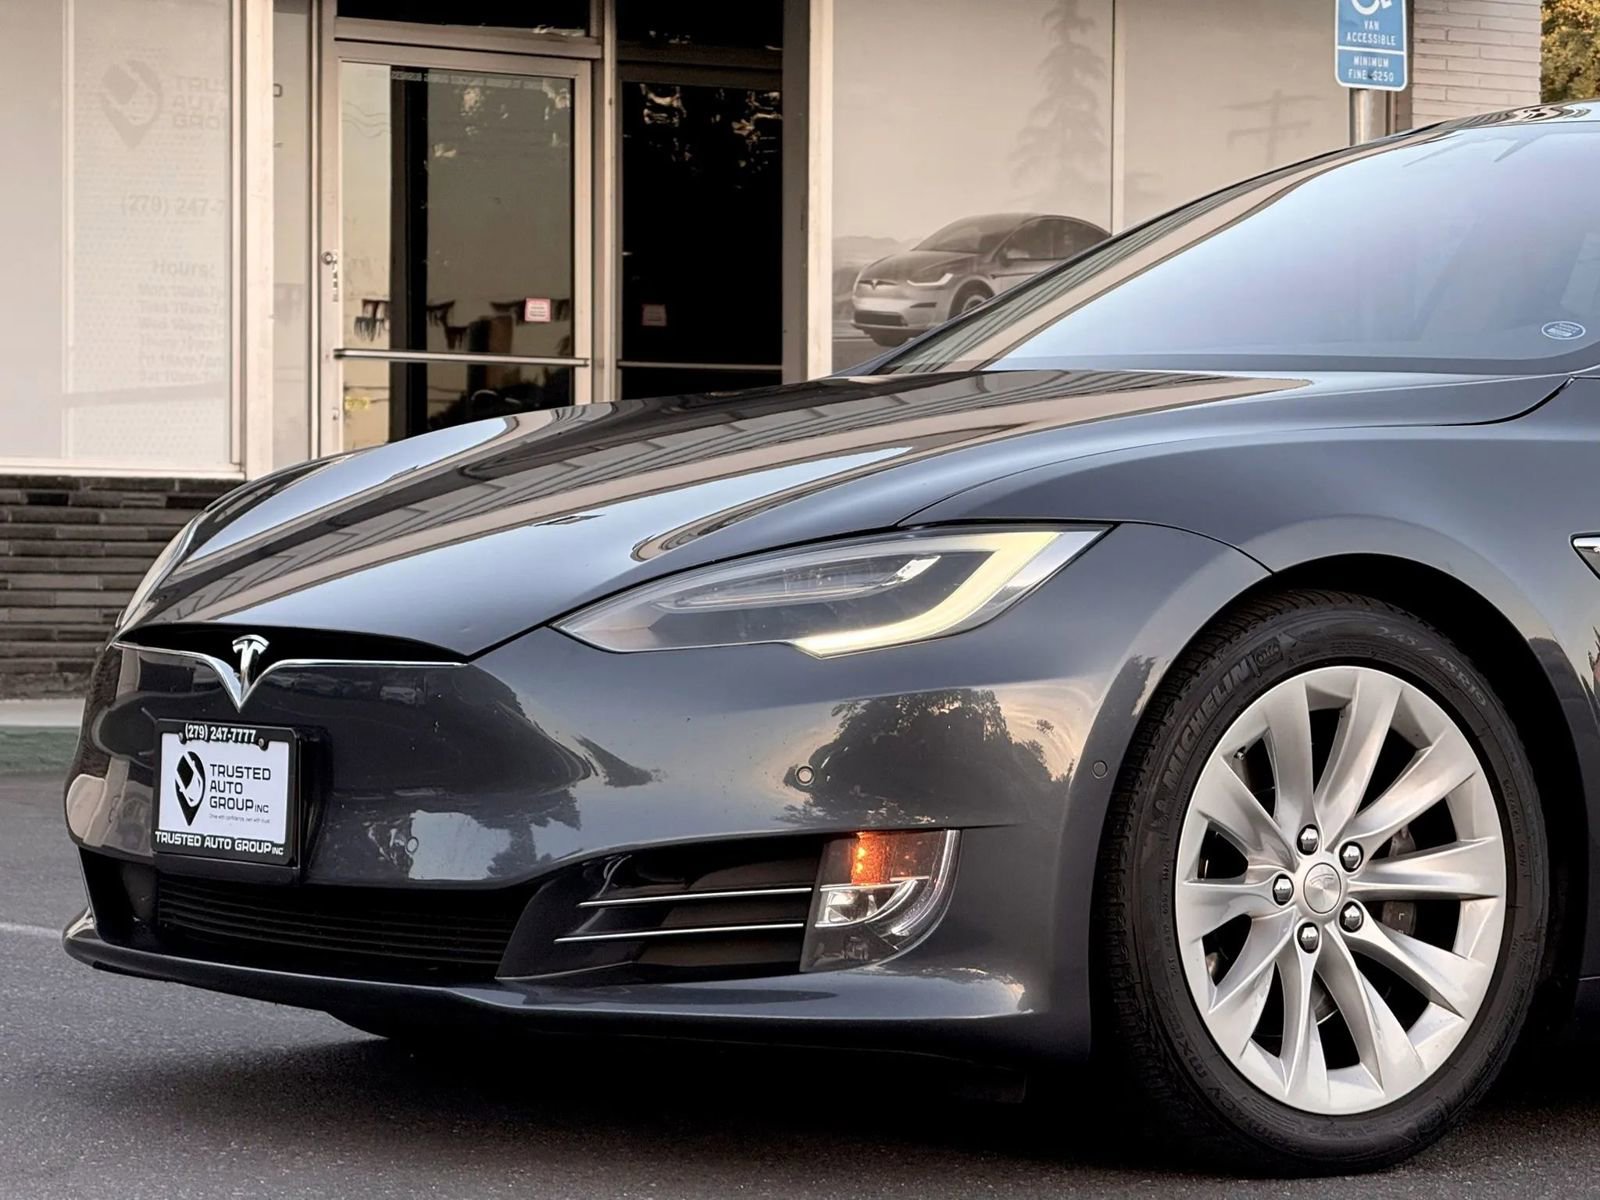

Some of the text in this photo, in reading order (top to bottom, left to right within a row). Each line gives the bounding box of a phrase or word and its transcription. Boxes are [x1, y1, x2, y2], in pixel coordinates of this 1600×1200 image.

[1364, 20, 1380, 31] VAN
[1346, 32, 1396, 46] ACCESSIBLE
[1353, 56, 1389, 67] MINIMUM
[1348, 68, 1394, 82] FINE $250
[1162, 657, 1250, 791] MICHELIN
[184, 723, 256, 743] (279) 247-7777
[209, 764, 271, 781] TRUSTED
[209, 780, 243, 795] AUTO
[209, 796, 269, 814] GROUP INC
[155, 831, 202, 847] TRUSTED
[204, 836, 232, 850] AUTO
[235, 840, 272, 854] GROUP
